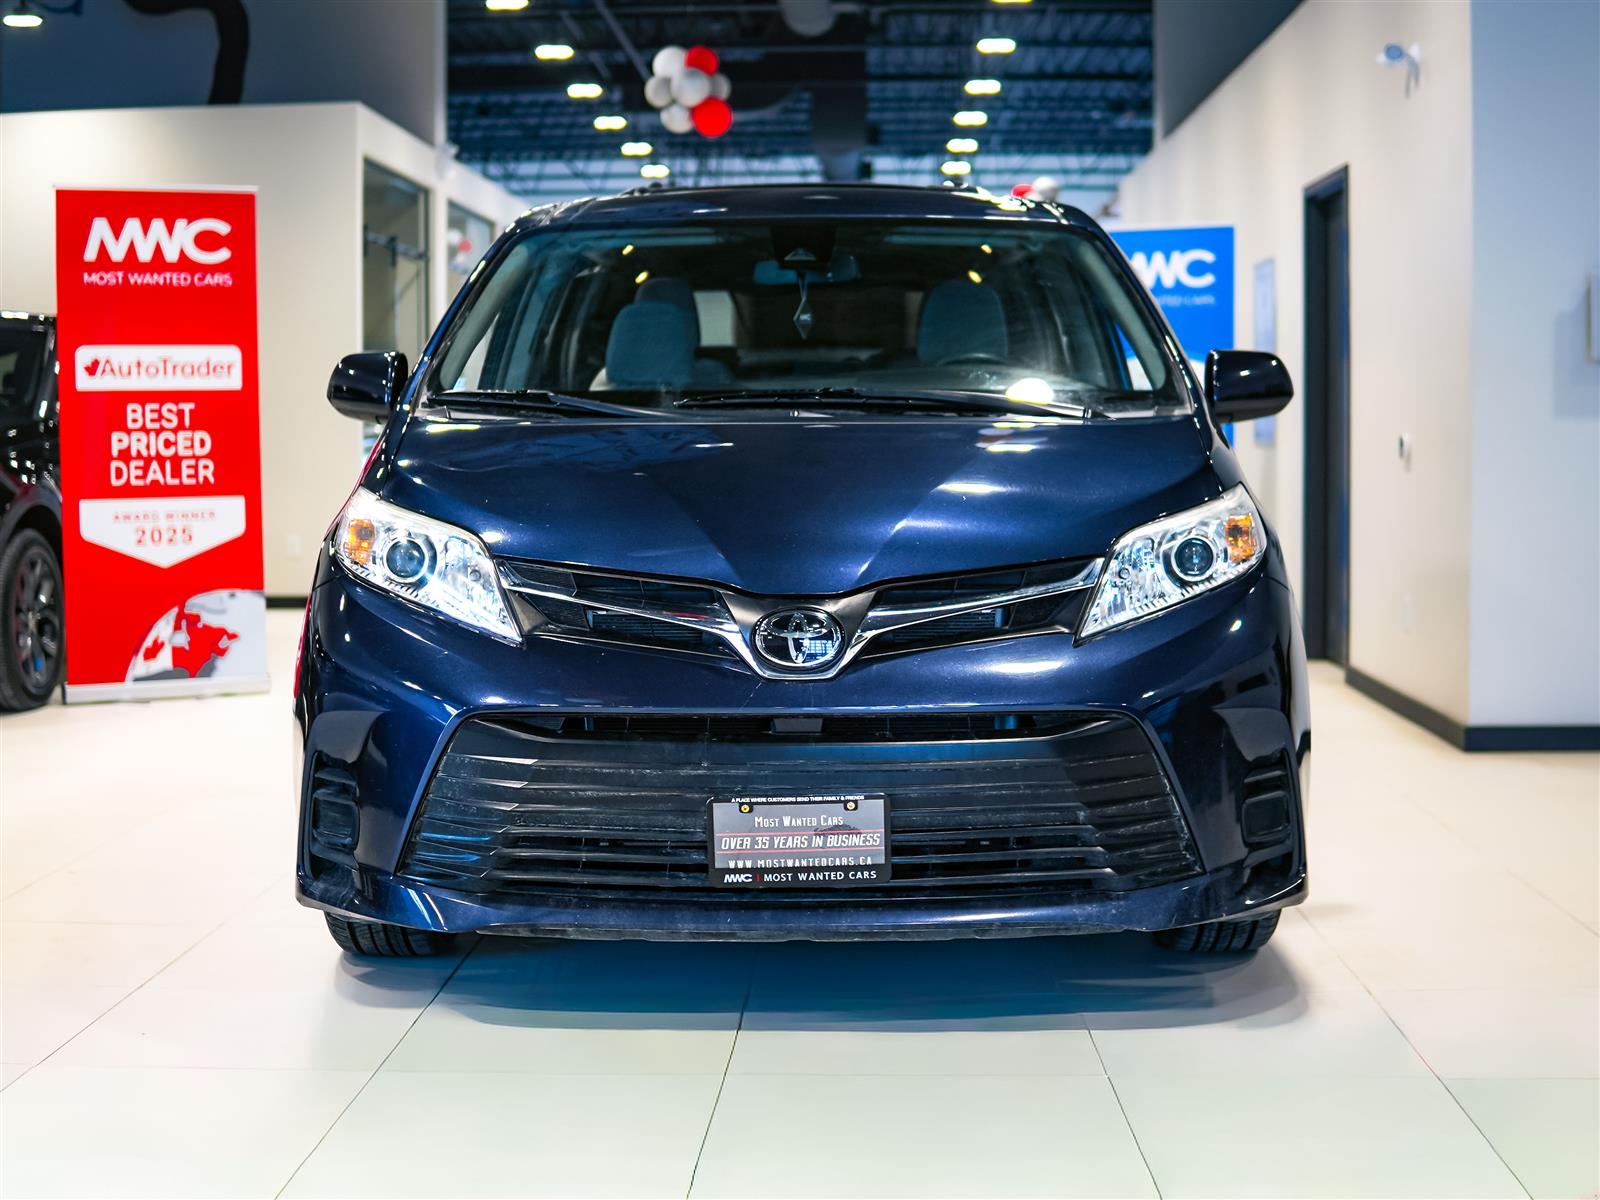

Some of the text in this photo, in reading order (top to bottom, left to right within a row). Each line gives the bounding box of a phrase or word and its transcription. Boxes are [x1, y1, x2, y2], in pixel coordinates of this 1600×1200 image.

[83, 216, 232, 264] MWC
[83, 271, 233, 287] MOST WANTED CARS
[100, 357, 235, 379] AutoTrader
[126, 402, 196, 430] BEST
[111, 430, 213, 458] PRICED
[110, 458, 215, 487] DEALER
[134, 526, 194, 546] 2025
[721, 833, 881, 850] OVER 35 YEARS IN BUSINESS
[723, 870, 877, 883] MWC MOST WANTED CARS
